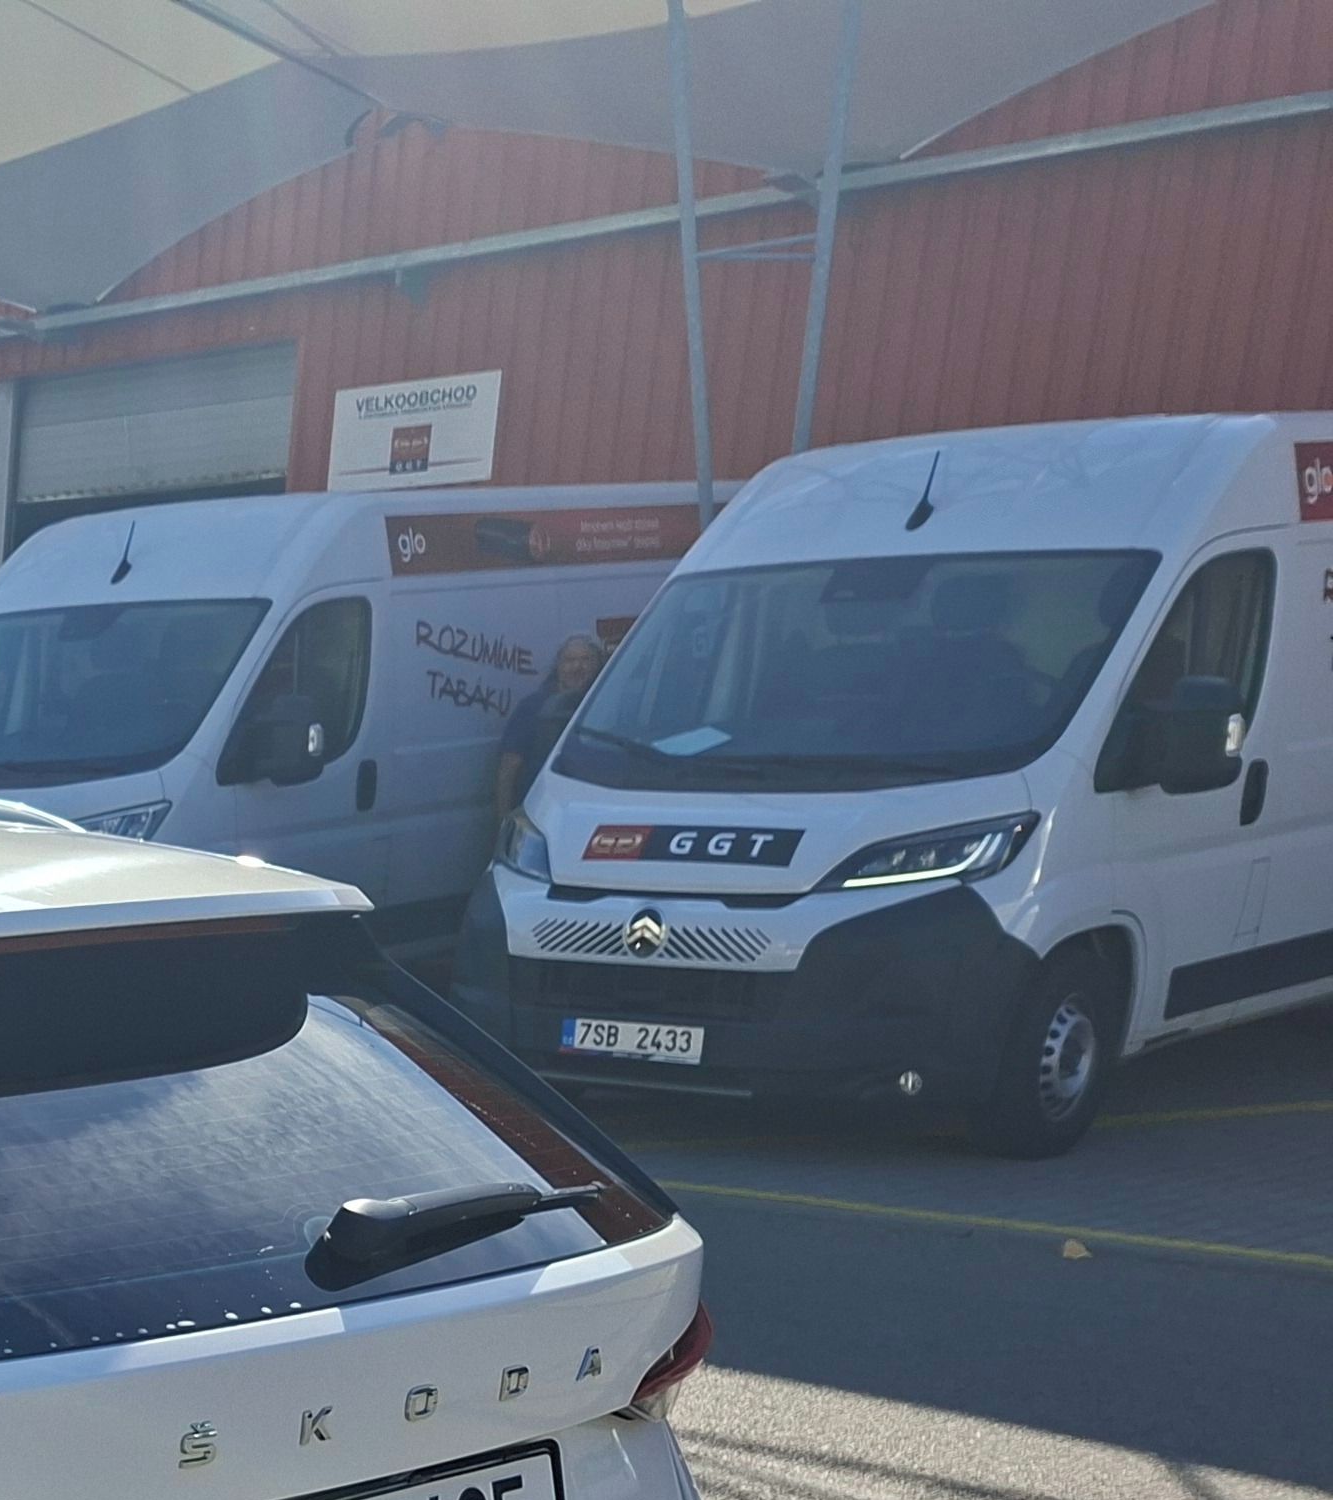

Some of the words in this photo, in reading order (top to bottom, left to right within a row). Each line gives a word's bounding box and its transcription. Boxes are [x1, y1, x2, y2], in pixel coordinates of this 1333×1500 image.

[355, 384, 478, 413] VELKOOBCHOD
[397, 528, 427, 563] glo
[415, 619, 538, 675] ROZUMÍME
[426, 670, 512, 717] TABÁKU
[669, 831, 774, 858] GGT
[578, 1022, 620, 1047] 7SB
[635, 1027, 693, 1052] 2433
[178, 1345, 602, 1469] ŠKODA
